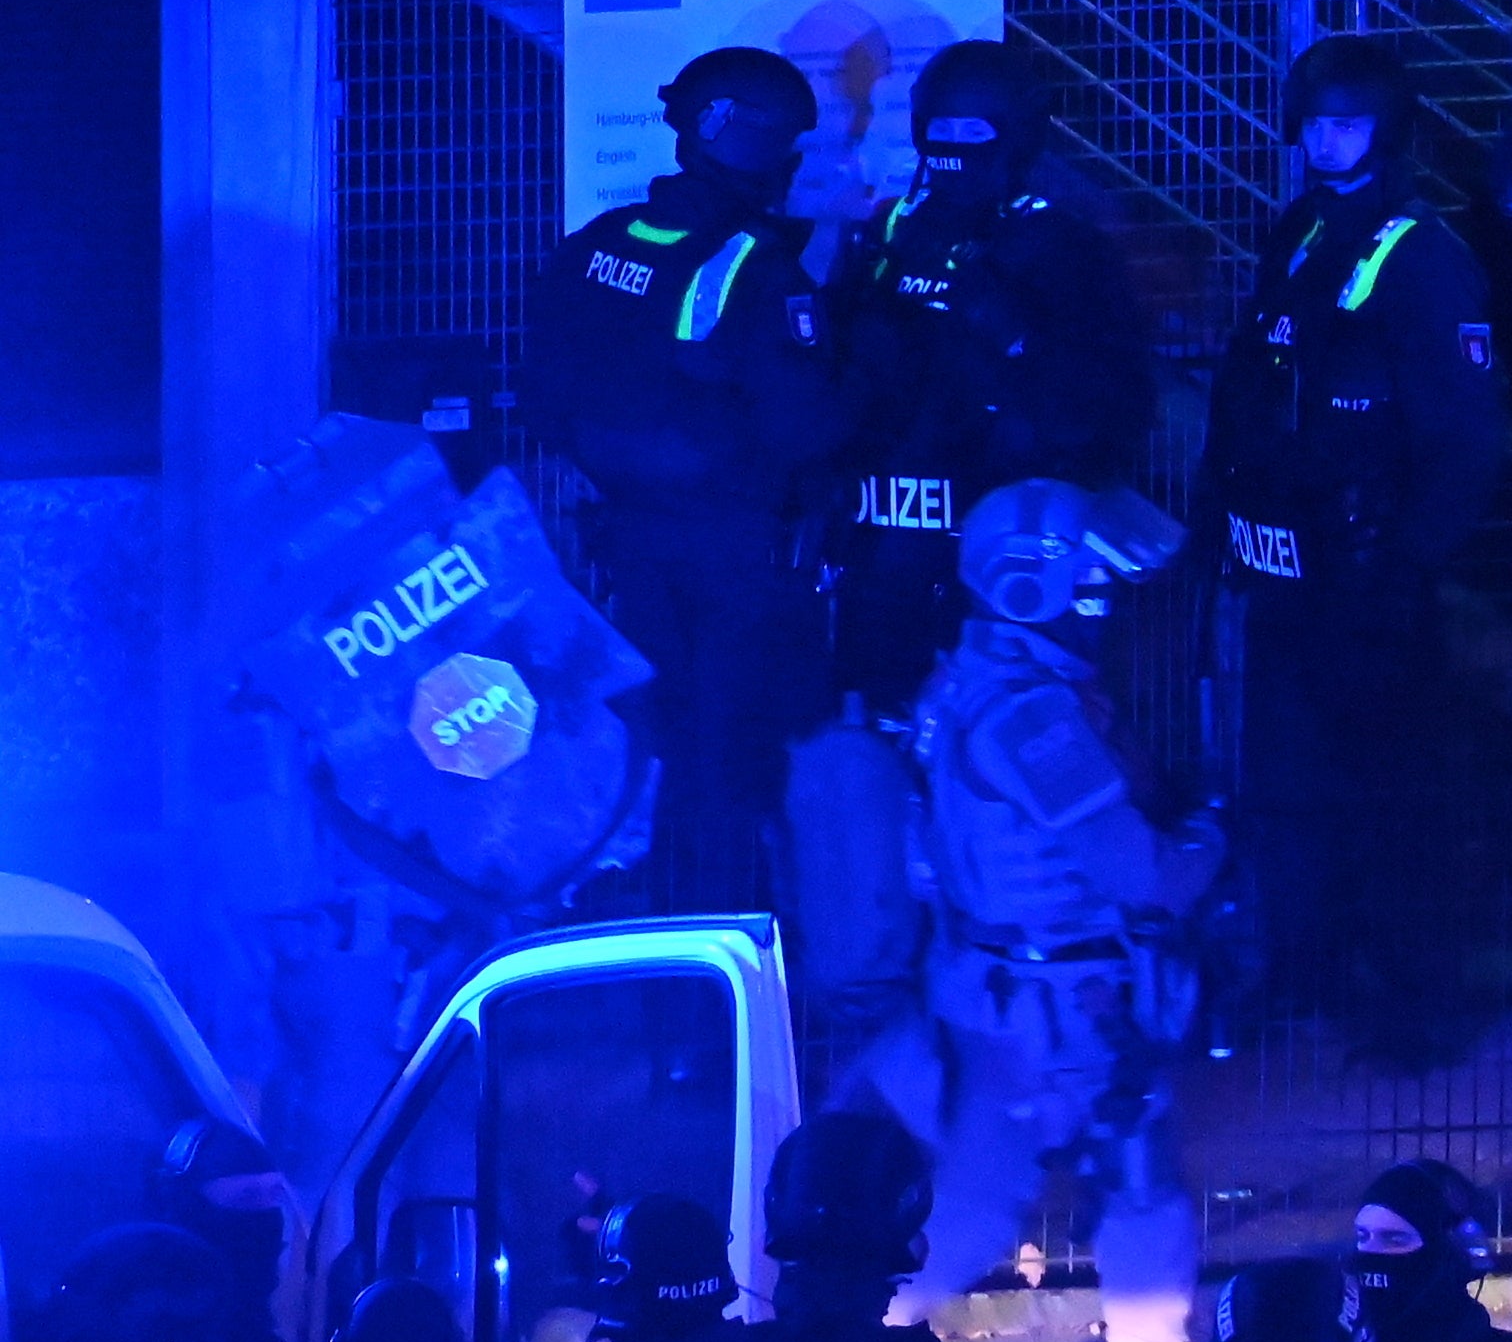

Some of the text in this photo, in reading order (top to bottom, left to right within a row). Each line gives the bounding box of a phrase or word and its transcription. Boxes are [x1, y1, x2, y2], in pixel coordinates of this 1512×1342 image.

[586, 251, 654, 297] POLIZEI
[1228, 511, 1301, 579] POLIZEI
[323, 543, 490, 680] POLIZEI
[431, 685, 513, 747] STOP
[657, 1275, 721, 1300] POLIZEI
